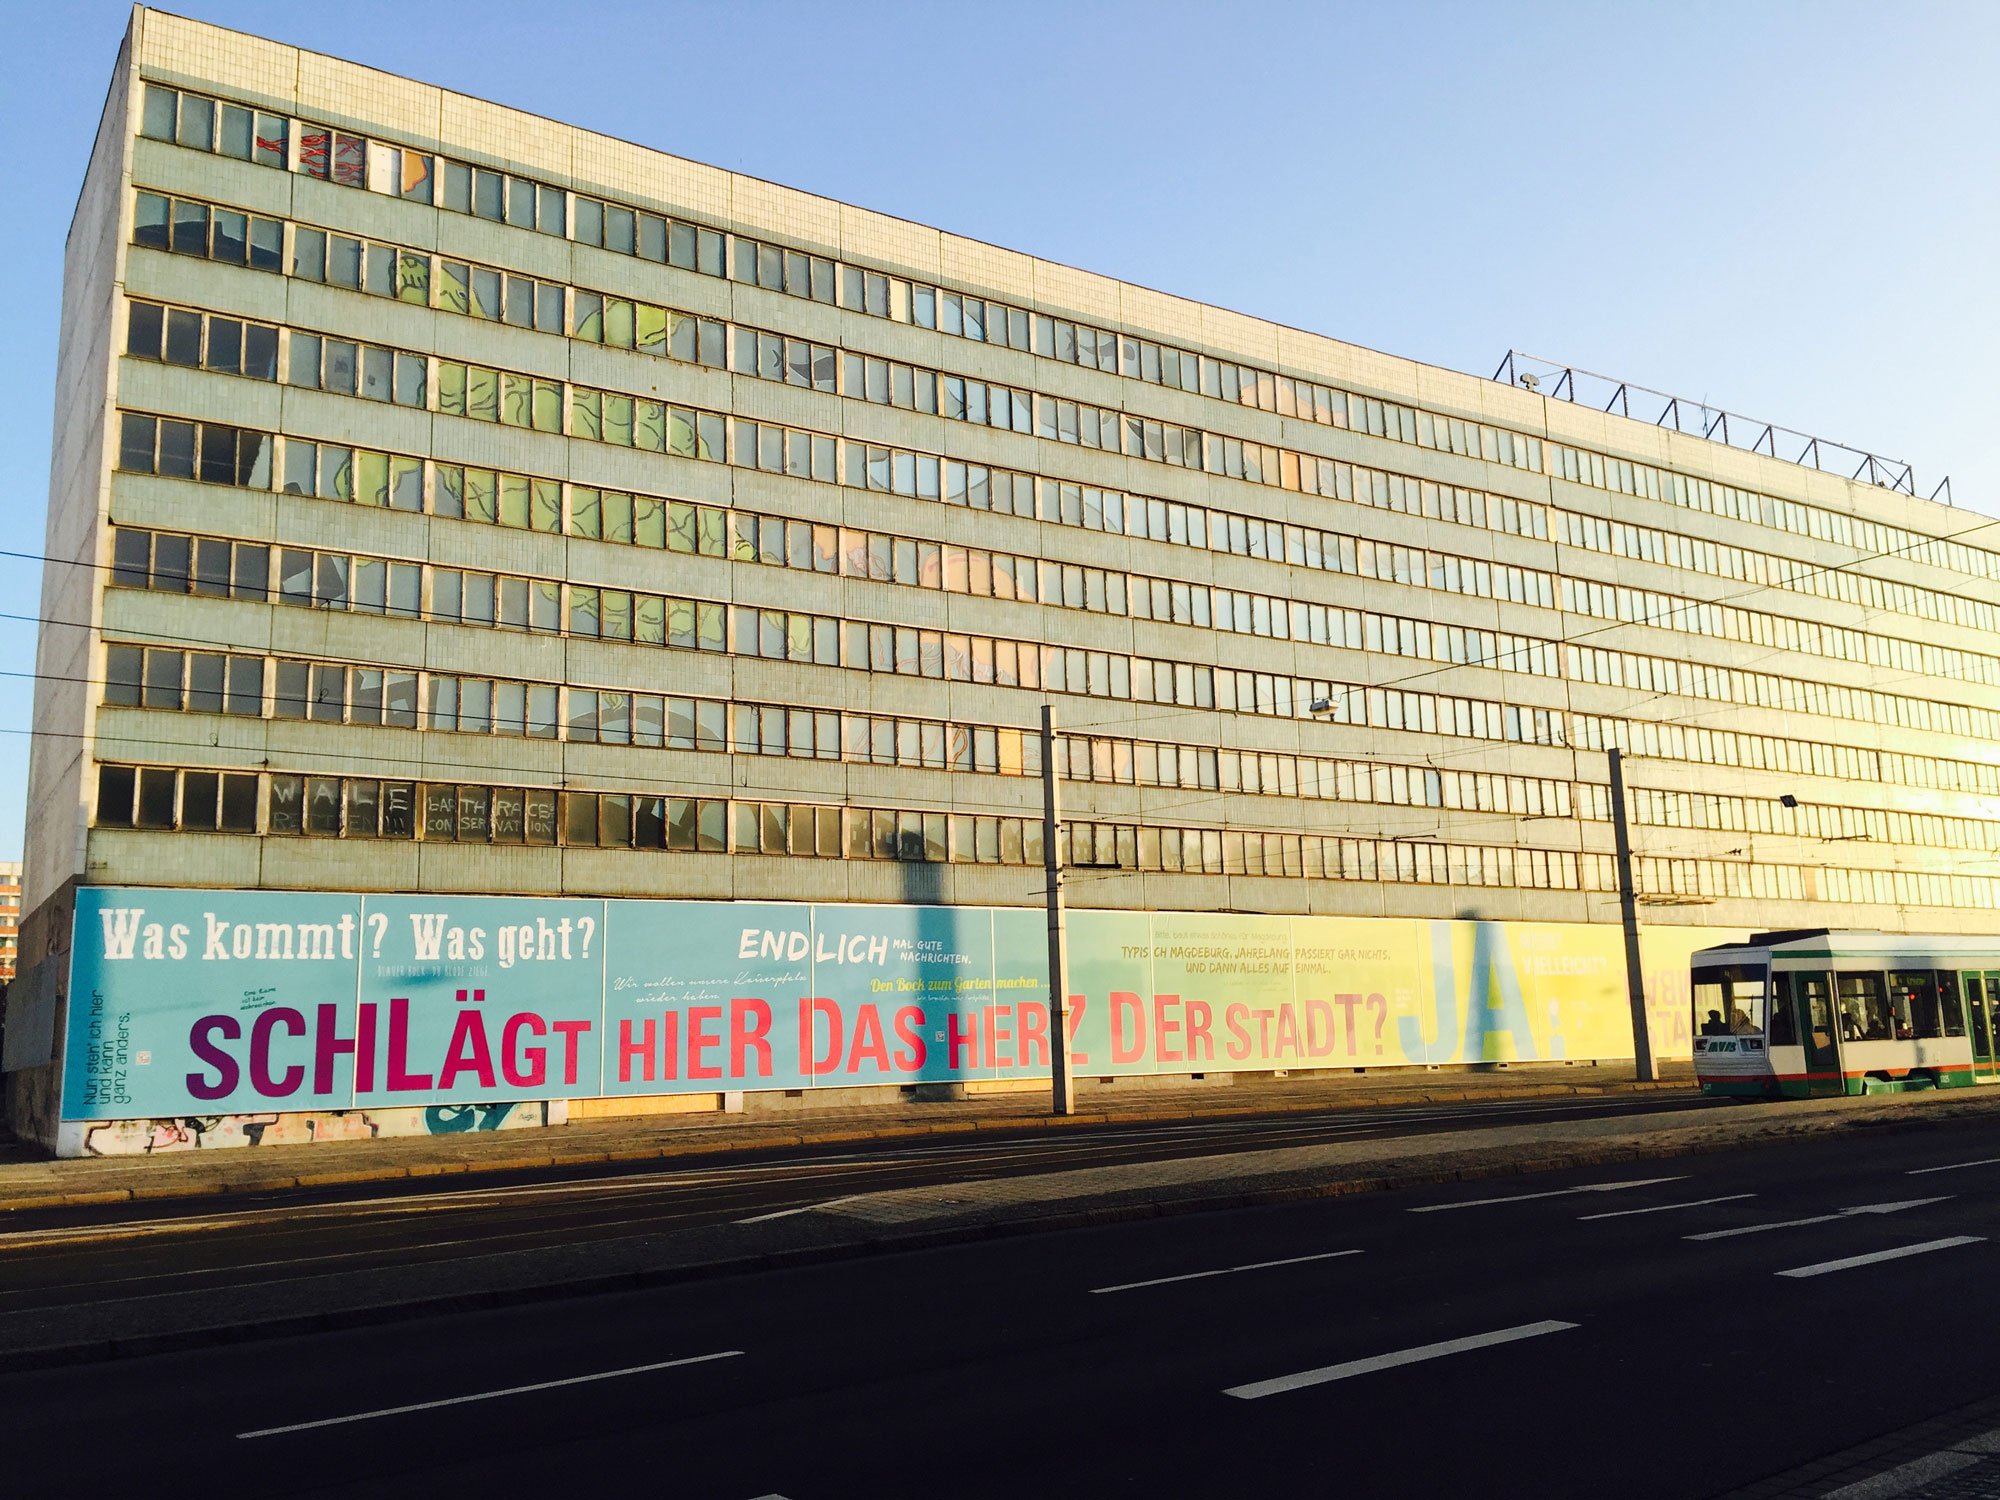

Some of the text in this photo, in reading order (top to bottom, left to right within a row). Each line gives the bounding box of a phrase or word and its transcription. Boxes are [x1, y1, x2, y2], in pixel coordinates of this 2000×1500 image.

[273, 782, 408, 811] WALE
[428, 796, 486, 815] EARTH
[427, 816, 553, 834] CONSERVATION
[99, 907, 388, 961] Was kommt?
[410, 912, 596, 969] Was geht?
[738, 929, 889, 966] ENDLICH
[892, 939, 943, 951] MAL GUTE
[1121, 946, 1167, 959] TYPISCH
[1234, 945, 1290, 961] JAHRELANG
[1295, 948, 1336, 961] PASSIERT
[1337, 949, 1357, 960] GAR
[900, 951, 972, 965] NACHRICHTEN.
[1185, 962, 1332, 975] UND DANN ALLES AUF EINMAL.
[613, 976, 638, 991] Wir
[688, 978, 730, 987] unsere
[871, 978, 895, 993] Den
[896, 976, 925, 992] Bock
[928, 980, 952, 991] zum
[954, 976, 991, 993] Garten
[996, 976, 1038, 990] machen
[83, 989, 104, 1105] Nun steh' ich hier
[186, 989, 592, 1101] SCHLÄGT
[619, 998, 774, 1083] HIER
[799, 997, 927, 1076] DAS
[947, 994, 1089, 1070] HERZ
[1109, 991, 1215, 1065] DER
[1226, 993, 1389, 1061] STADT?
[1708, 1041, 1738, 1053] MVB
[98, 1040, 114, 1105] und kann
[113, 1012, 132, 1105] ganz anders.
